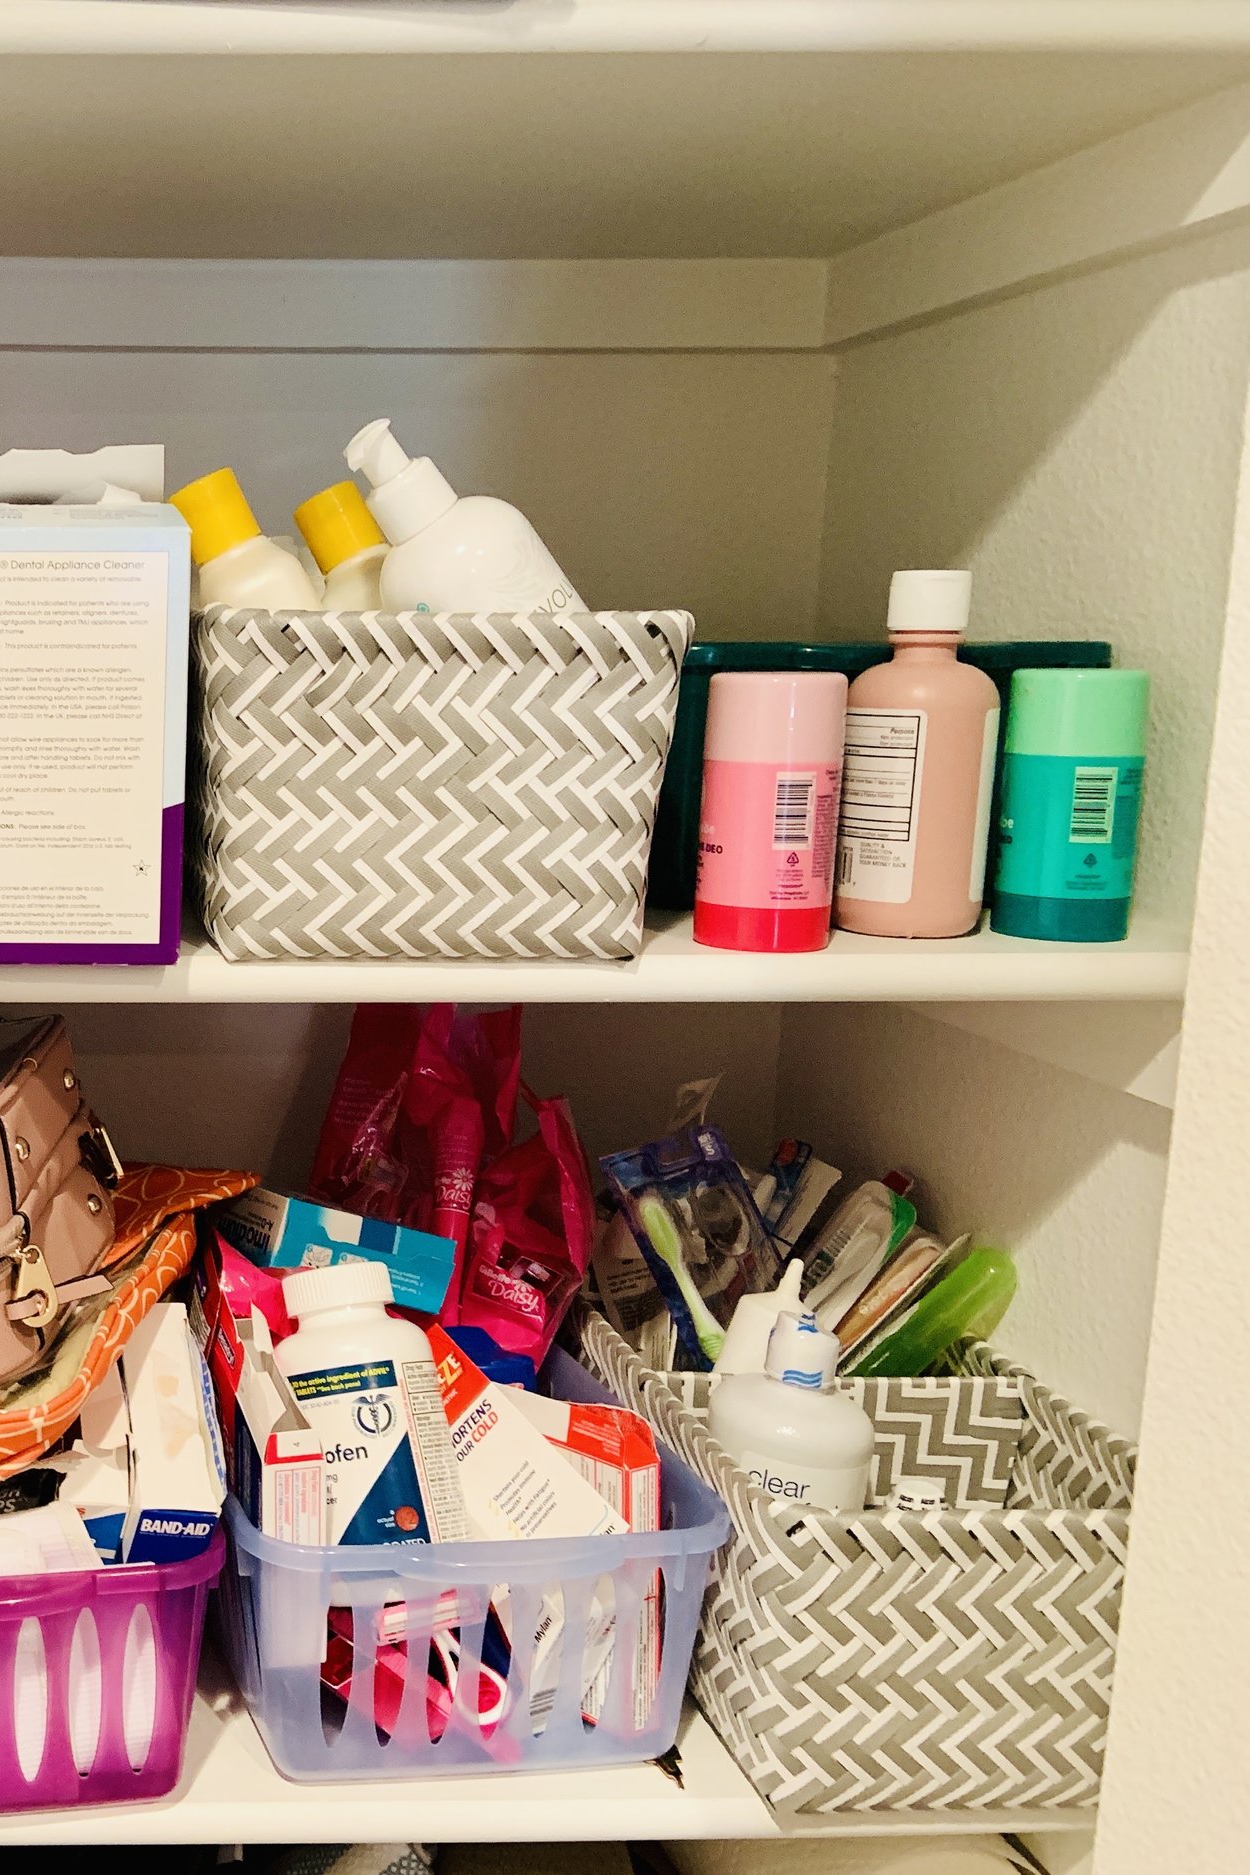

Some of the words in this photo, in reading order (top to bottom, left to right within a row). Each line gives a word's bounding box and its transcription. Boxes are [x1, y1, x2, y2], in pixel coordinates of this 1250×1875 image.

[10, 560, 44, 569] Dental
[47, 560, 100, 572] Appliance
[103, 560, 145, 570] Cleaner
[488, 1279, 539, 1312] Daisy
[308, 1377, 326, 1386] active
[327, 1372, 360, 1383] ingredient
[452, 1399, 492, 1449] ORTENS
[457, 1441, 474, 1462] OUR
[471, 1411, 499, 1443] COLD
[493, 1481, 512, 1502] Shortens
[511, 1471, 522, 1484] your
[521, 1460, 529, 1473] cold
[748, 1469, 811, 1500] clear
[140, 1518, 211, 1536] BAND-AID
[533, 1614, 553, 1643] Mylan
